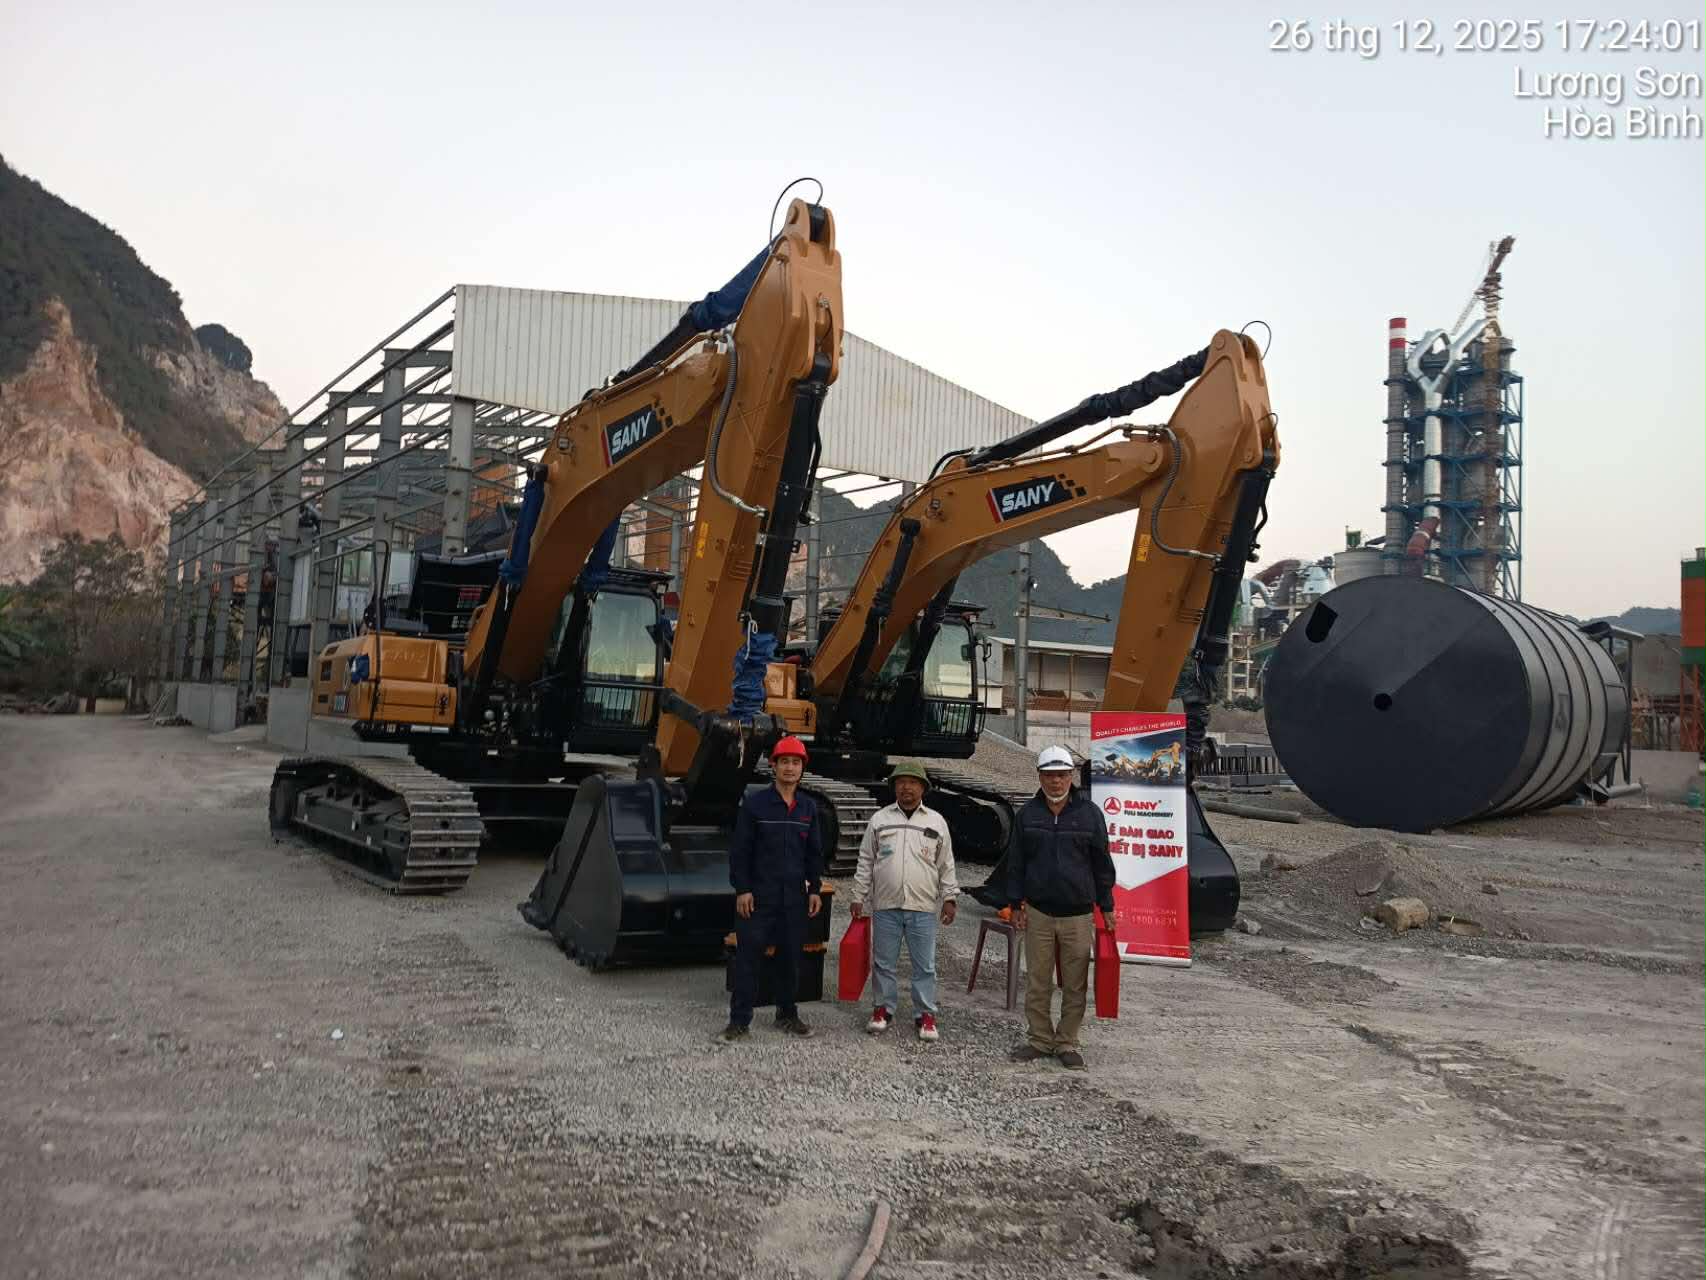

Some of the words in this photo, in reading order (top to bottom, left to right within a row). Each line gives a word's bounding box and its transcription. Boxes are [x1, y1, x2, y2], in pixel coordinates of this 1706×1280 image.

[611, 411, 652, 456] SANY
[1002, 481, 1055, 513] SANY
[1096, 728, 1119, 737] QUALITY
[1148, 722, 1159, 730] THE
[1160, 720, 1181, 729] WORLD
[1124, 800, 1157, 811] SANY
[1146, 828, 1175, 840] GIAO
[1149, 844, 1184, 858] SANY
